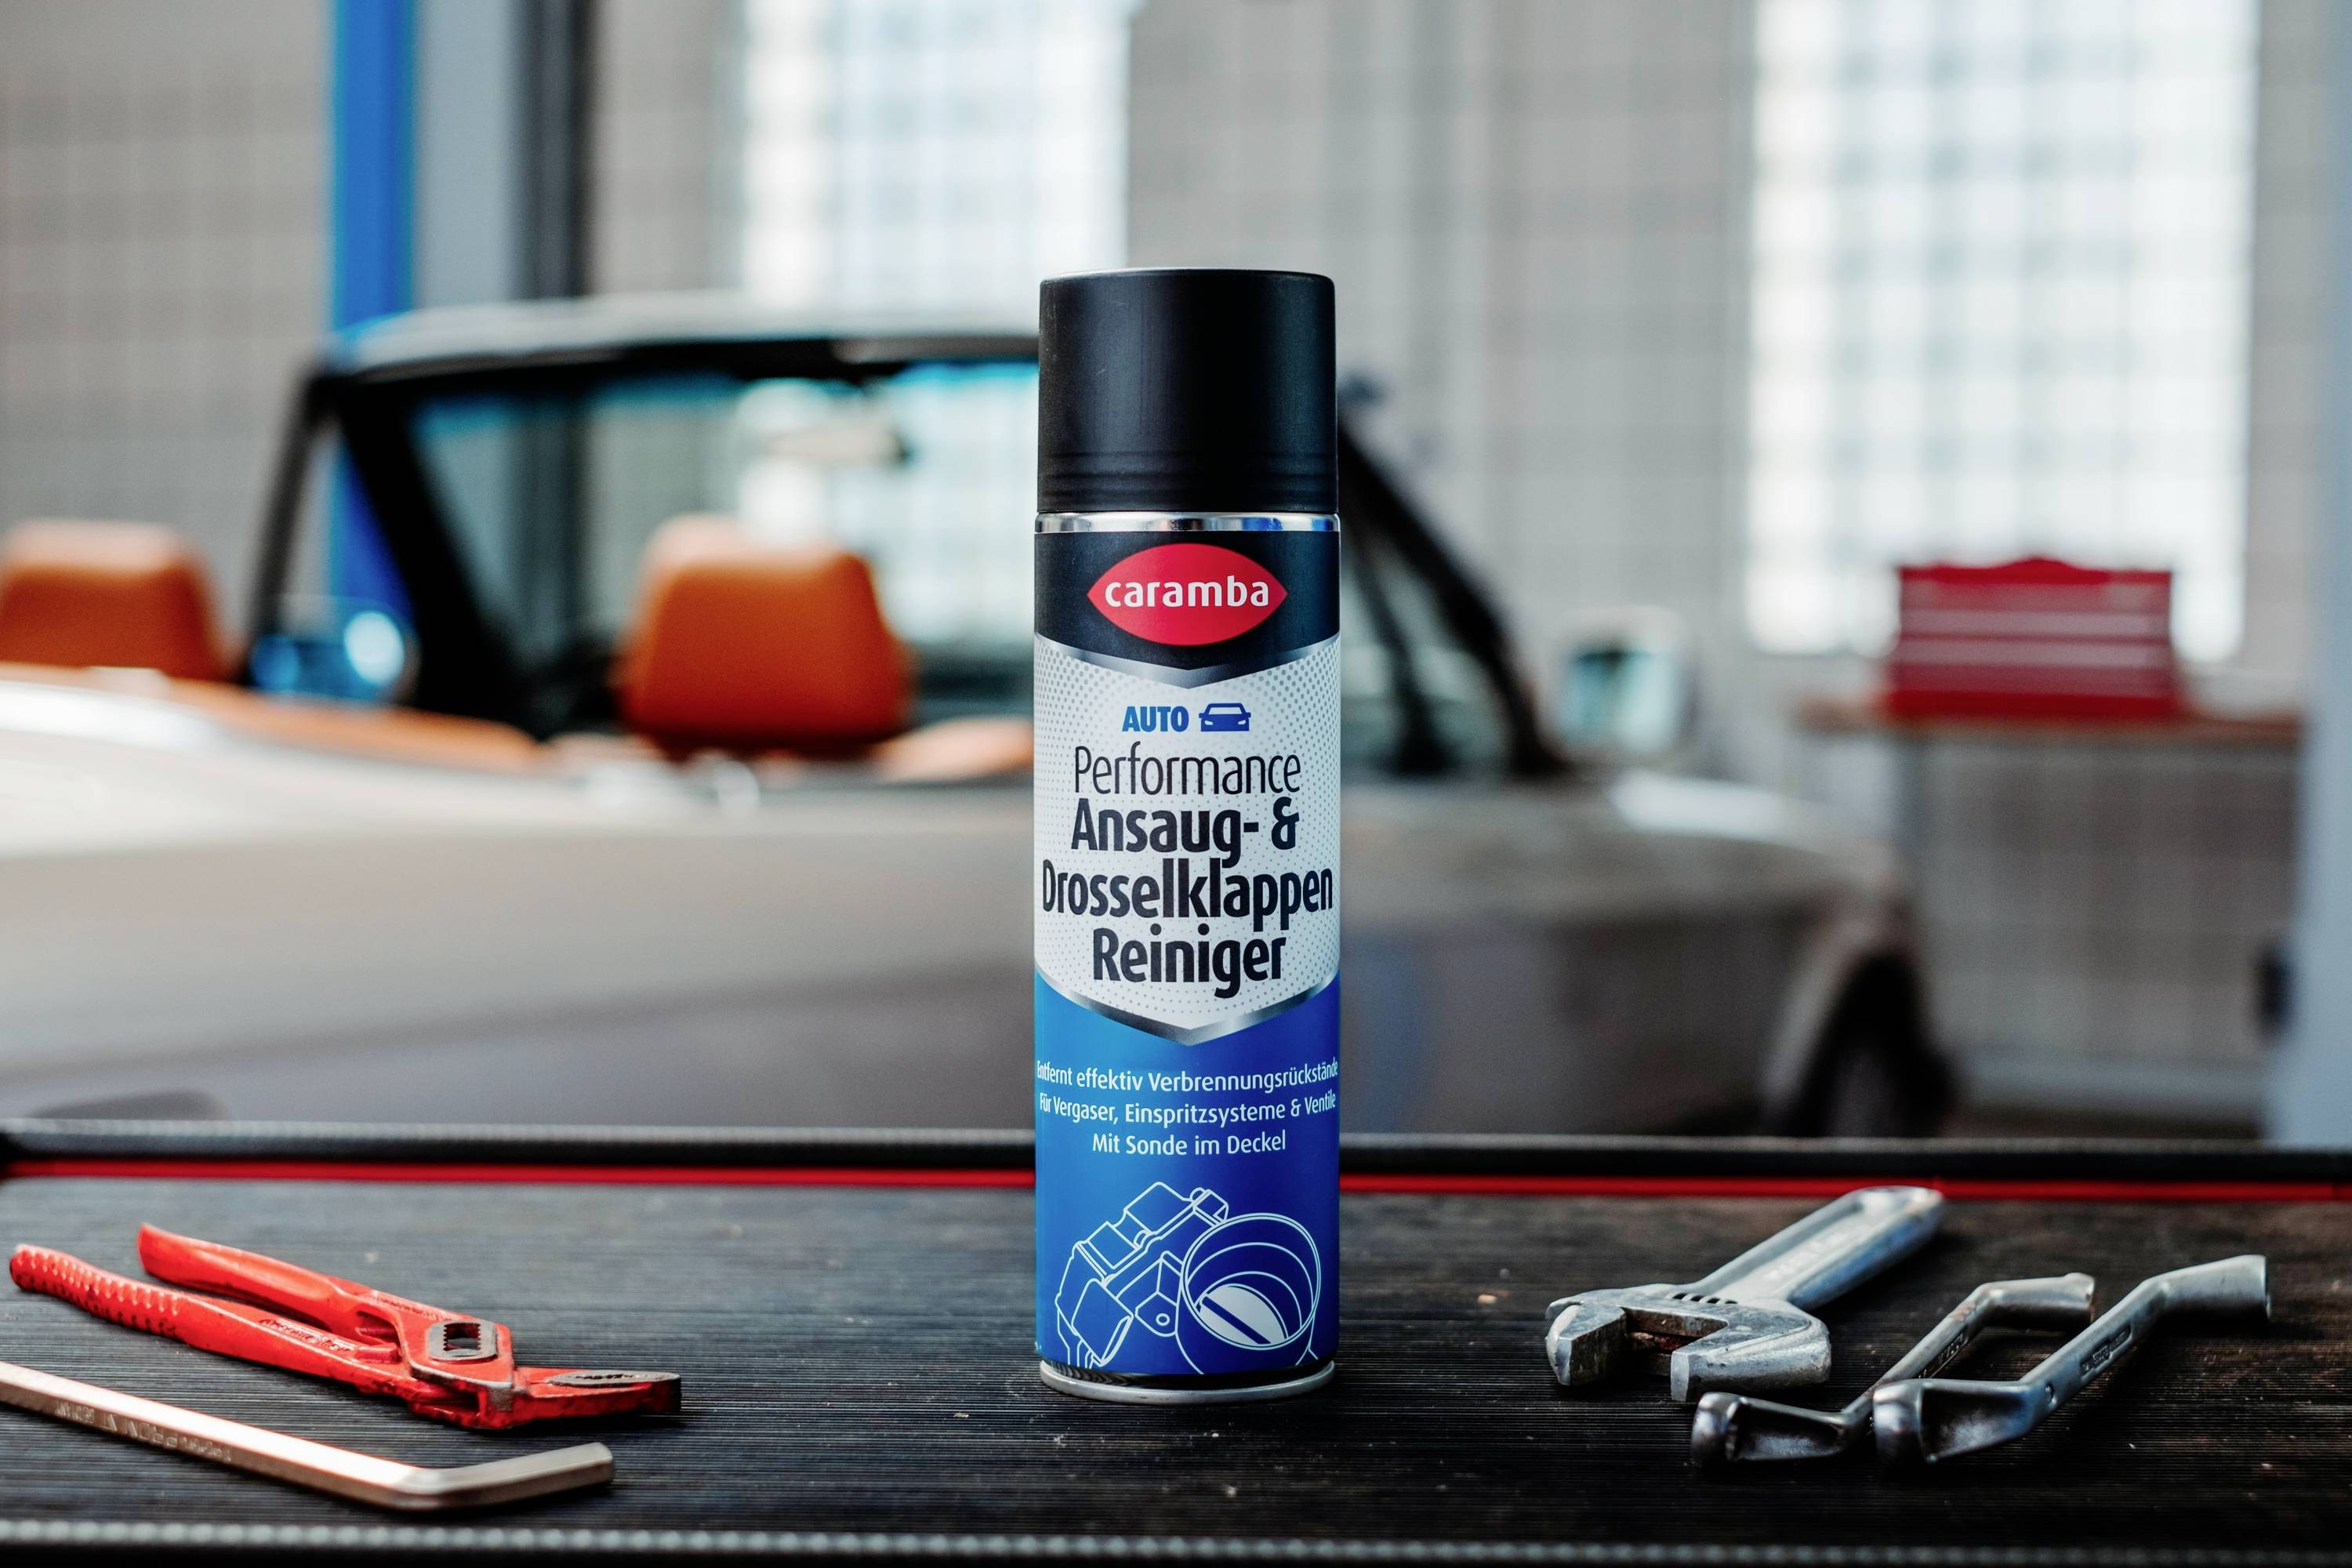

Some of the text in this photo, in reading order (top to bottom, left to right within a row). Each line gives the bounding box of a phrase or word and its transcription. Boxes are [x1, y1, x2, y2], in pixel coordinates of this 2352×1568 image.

[1104, 575, 1269, 608] caramba
[1121, 706, 1189, 732] AUTO
[1075, 741, 1301, 795] Performance
[1071, 797, 1300, 868] Ansaug- &
[1043, 857, 1333, 932] Drosselklappen
[1093, 923, 1287, 999] Reiniger
[1036, 1056, 1338, 1094] Entfernt effektiv Verbrennungsrückstände
[1040, 1088, 1336, 1129] Für Vergaser, Einspritzsysteme & Ventile
[1092, 1129, 1286, 1156] Mit Sonde im Deckel
